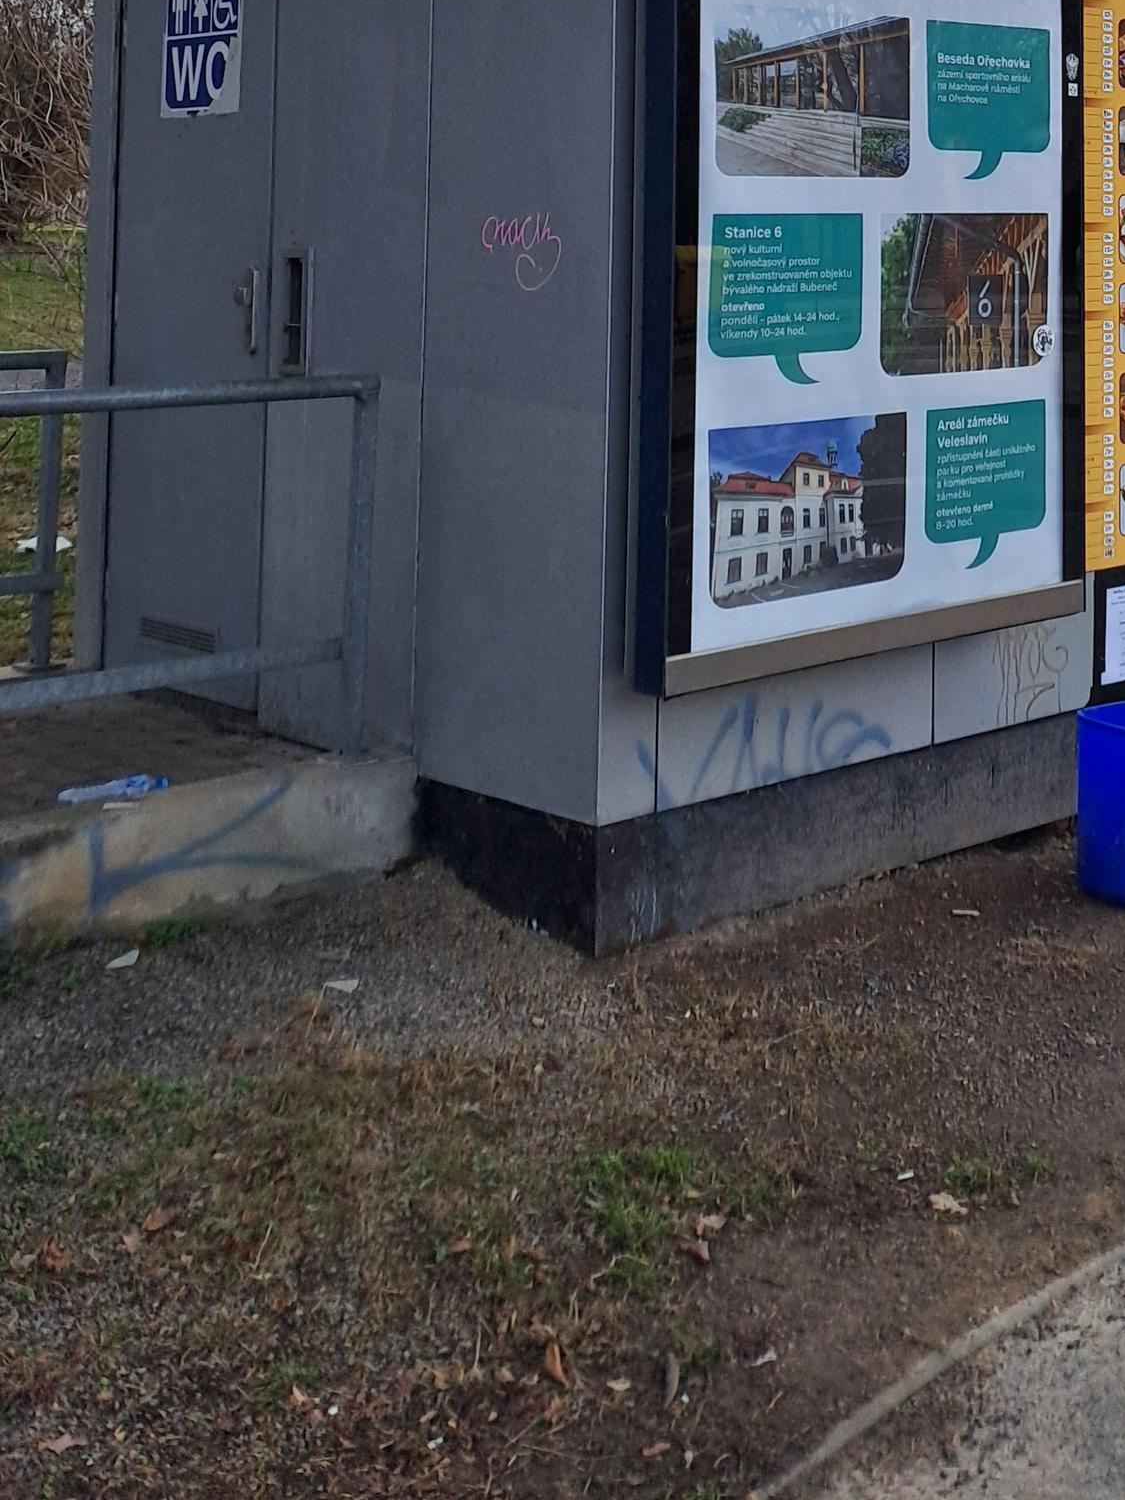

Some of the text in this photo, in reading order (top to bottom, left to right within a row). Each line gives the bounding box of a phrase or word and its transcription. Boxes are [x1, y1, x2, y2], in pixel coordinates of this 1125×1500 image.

[937, 52, 1031, 69] Beseda Ořechovka
[171, 40, 231, 102] WC
[724, 226, 782, 239] Stanice 6
[724, 244, 782, 256] nový kulturní
[731, 257, 786, 269] volnočasový
[788, 257, 820, 268] prostor
[722, 268, 852, 281] ve zrekonstruovaném objektu
[722, 281, 838, 296] bývalého nádraží Bubeneč
[976, 280, 993, 318] 6
[721, 301, 765, 312] otevřeno
[720, 315, 758, 327] pondělí
[766, 313, 791, 325] pátek
[720, 327, 759, 340] víkendy
[786, 325, 807, 336] hod.
[937, 413, 1009, 431] Areál zámečku
[937, 432, 988, 448] Veleslavín
[936, 465, 960, 478] parku
[961, 465, 974, 476] pro
[936, 489, 972, 502] zámečku
[936, 500, 994, 518] otevřeno denně
